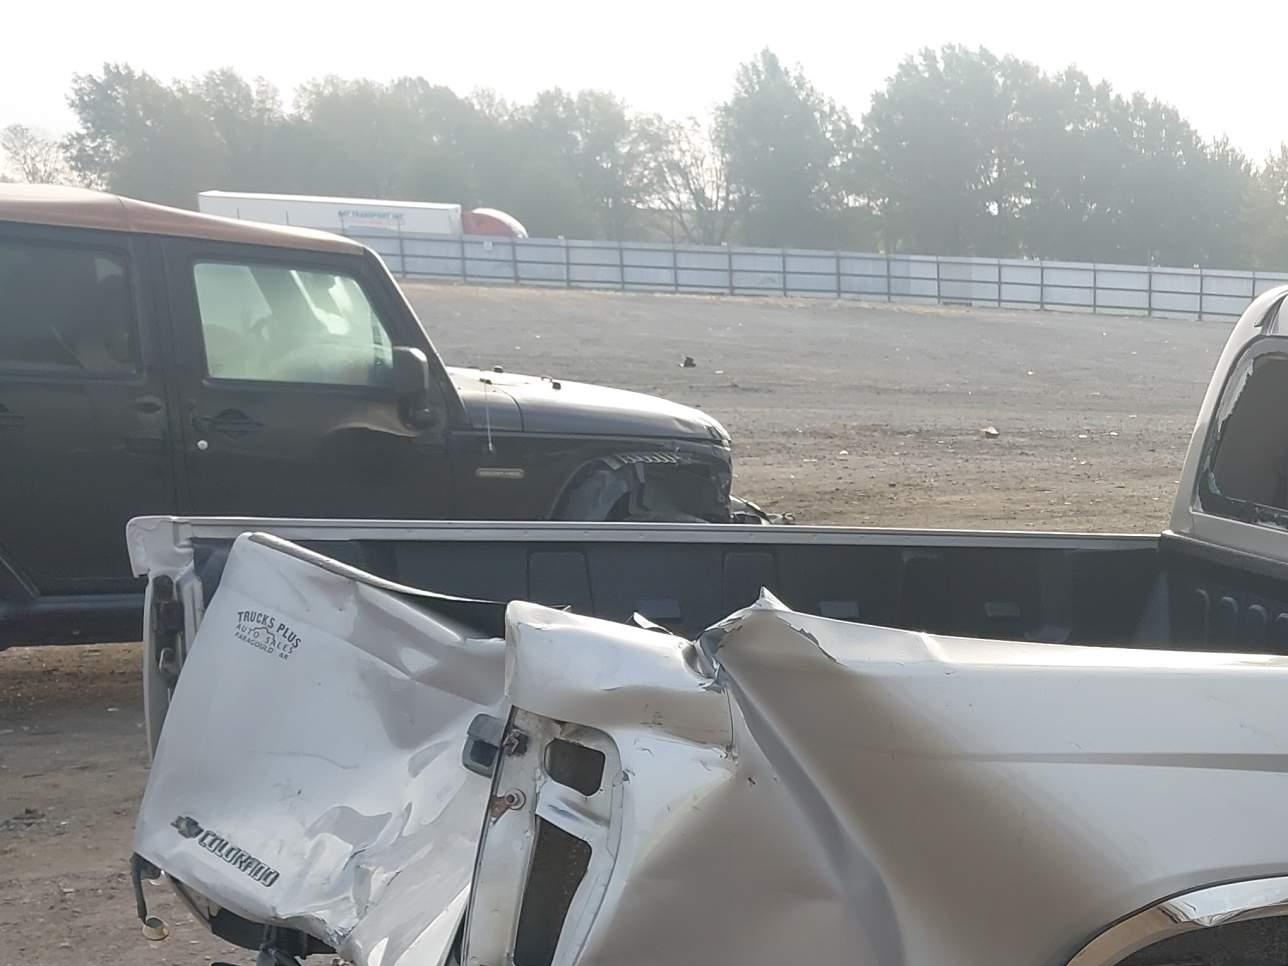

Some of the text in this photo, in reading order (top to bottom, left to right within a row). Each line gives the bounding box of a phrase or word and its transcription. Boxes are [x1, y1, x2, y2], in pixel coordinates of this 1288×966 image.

[235, 623, 294, 654] AUTO SALES
[237, 610, 302, 648] TRUCKS PLUS
[197, 829, 281, 888] COLORADO
